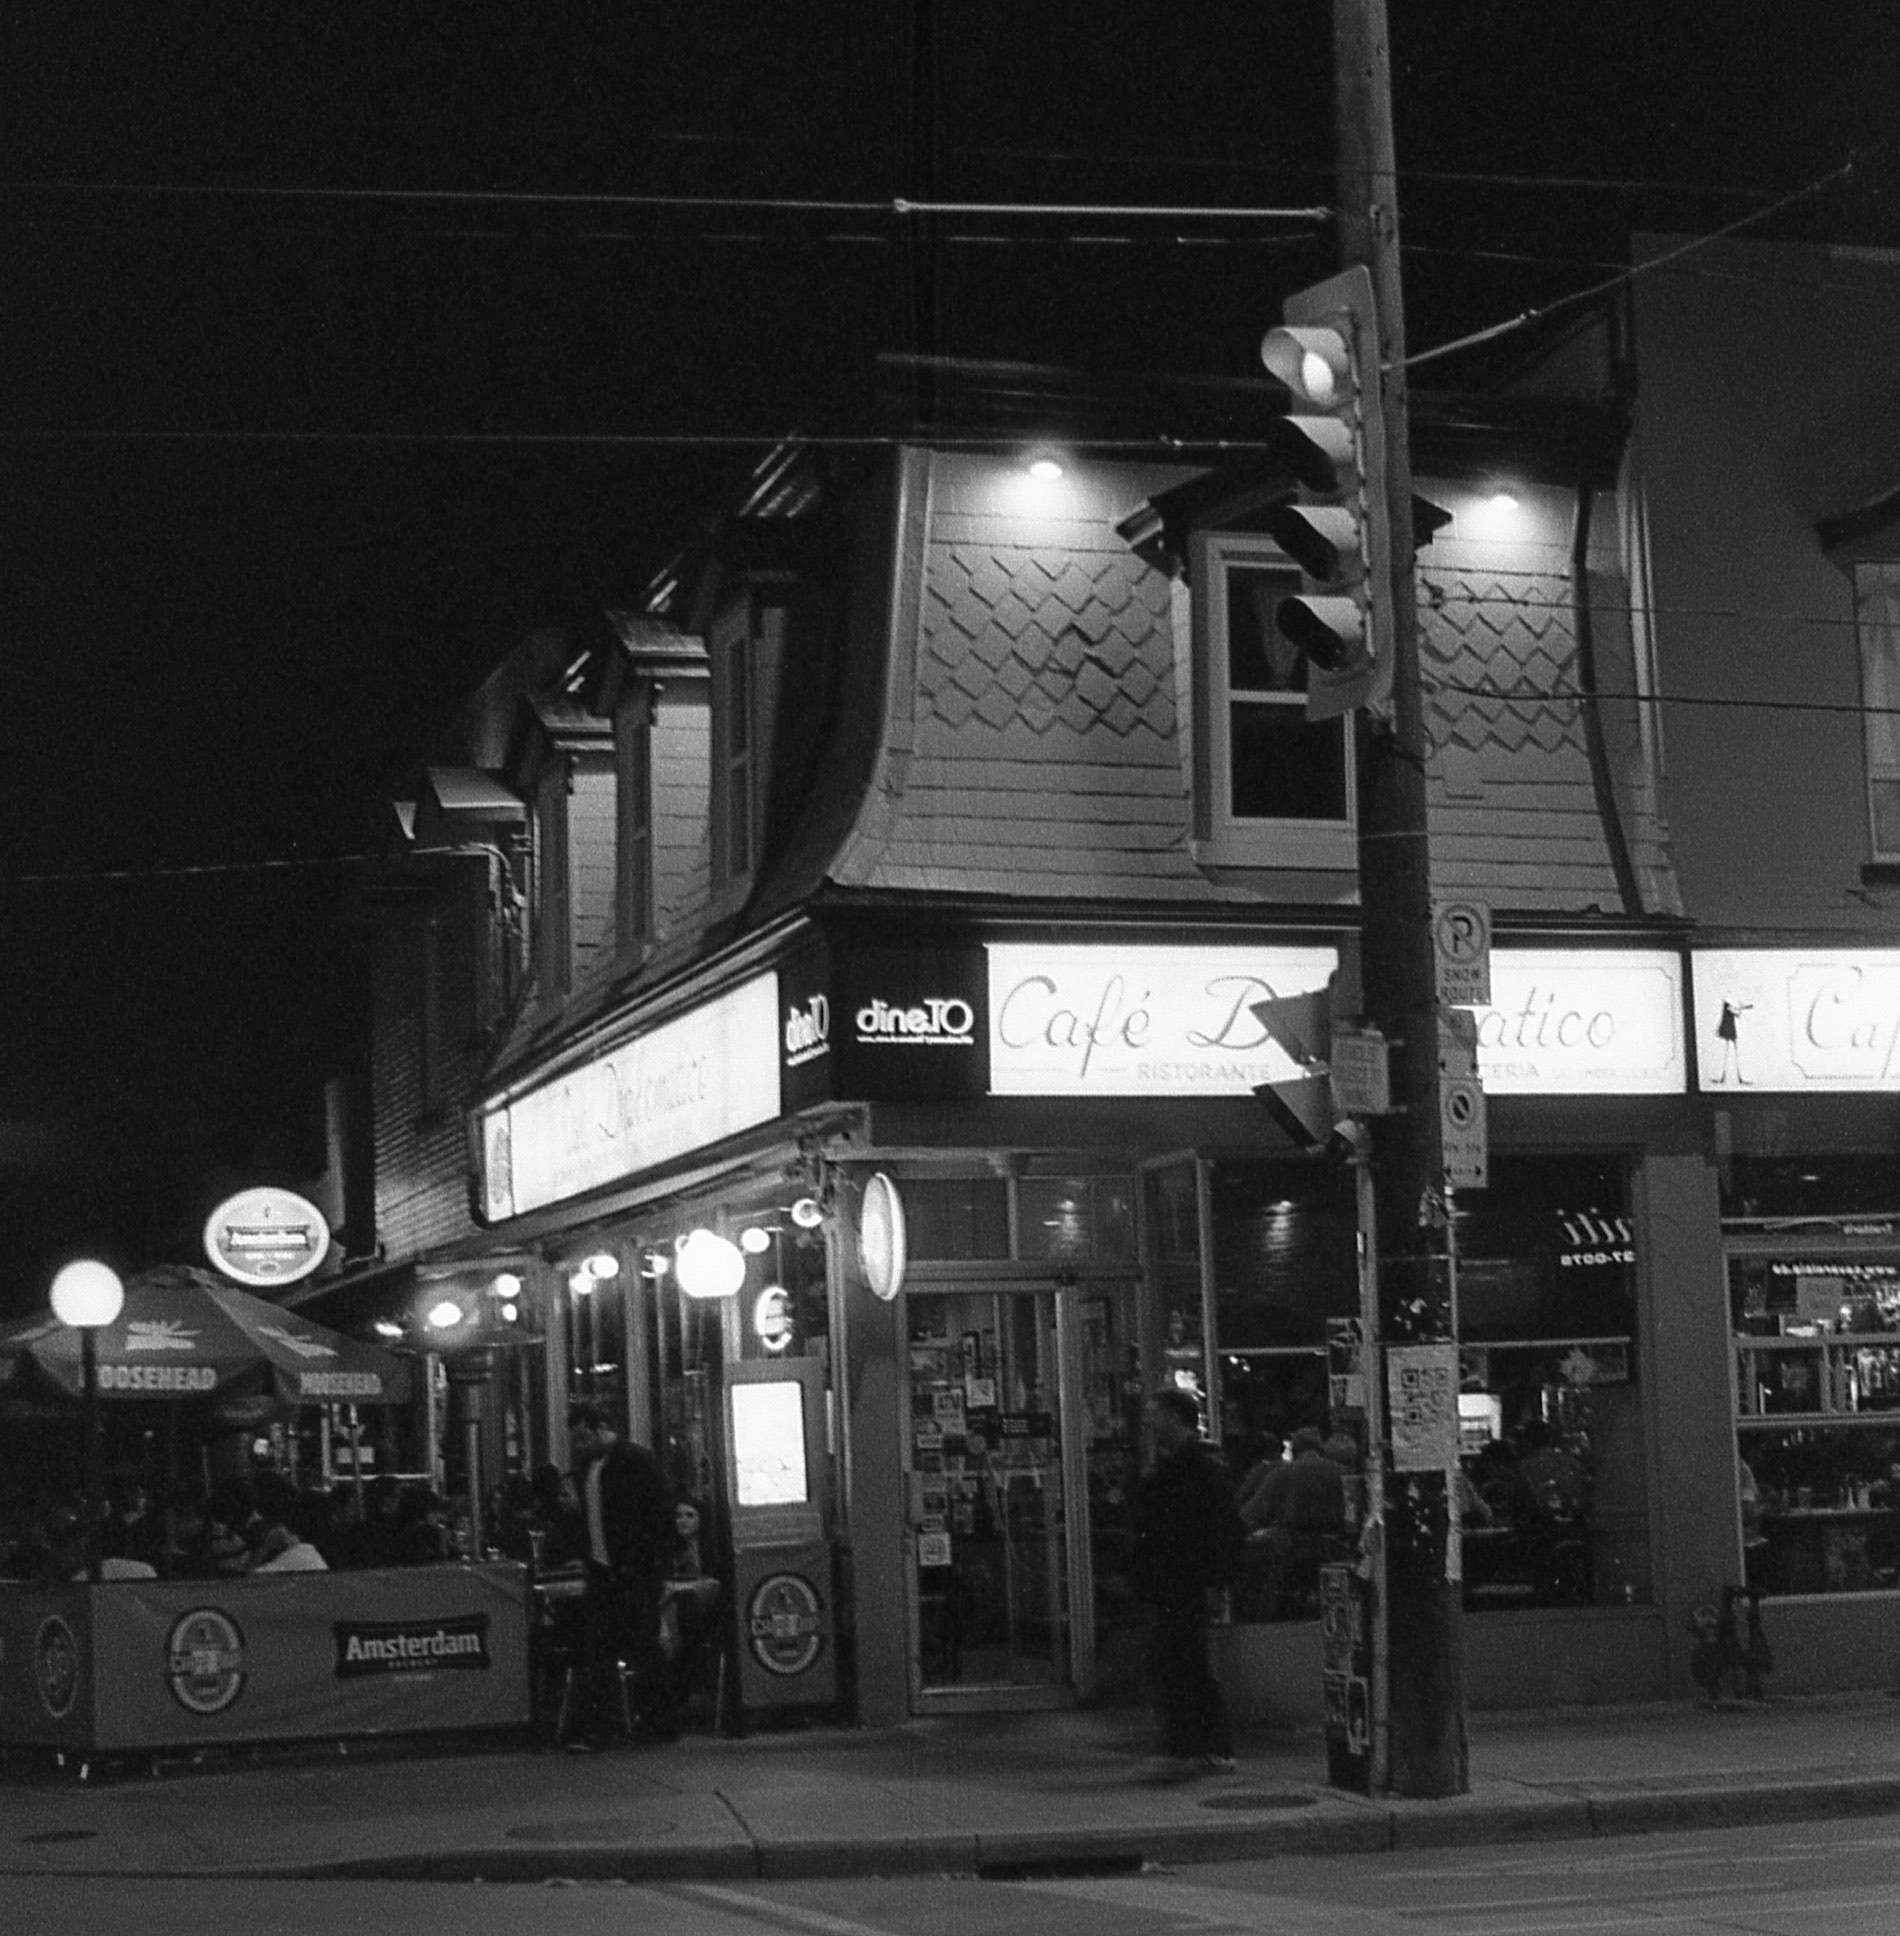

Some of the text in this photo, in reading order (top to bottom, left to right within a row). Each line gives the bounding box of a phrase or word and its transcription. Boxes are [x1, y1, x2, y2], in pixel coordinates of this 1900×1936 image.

[1443, 968, 1482, 983] SNOW
[999, 974, 1151, 1078] Café
[1136, 1063, 1271, 1080] RISTORANTE
[96, 1365, 218, 1391] OOSEHEAD
[346, 1629, 482, 1661] Amsterdam
